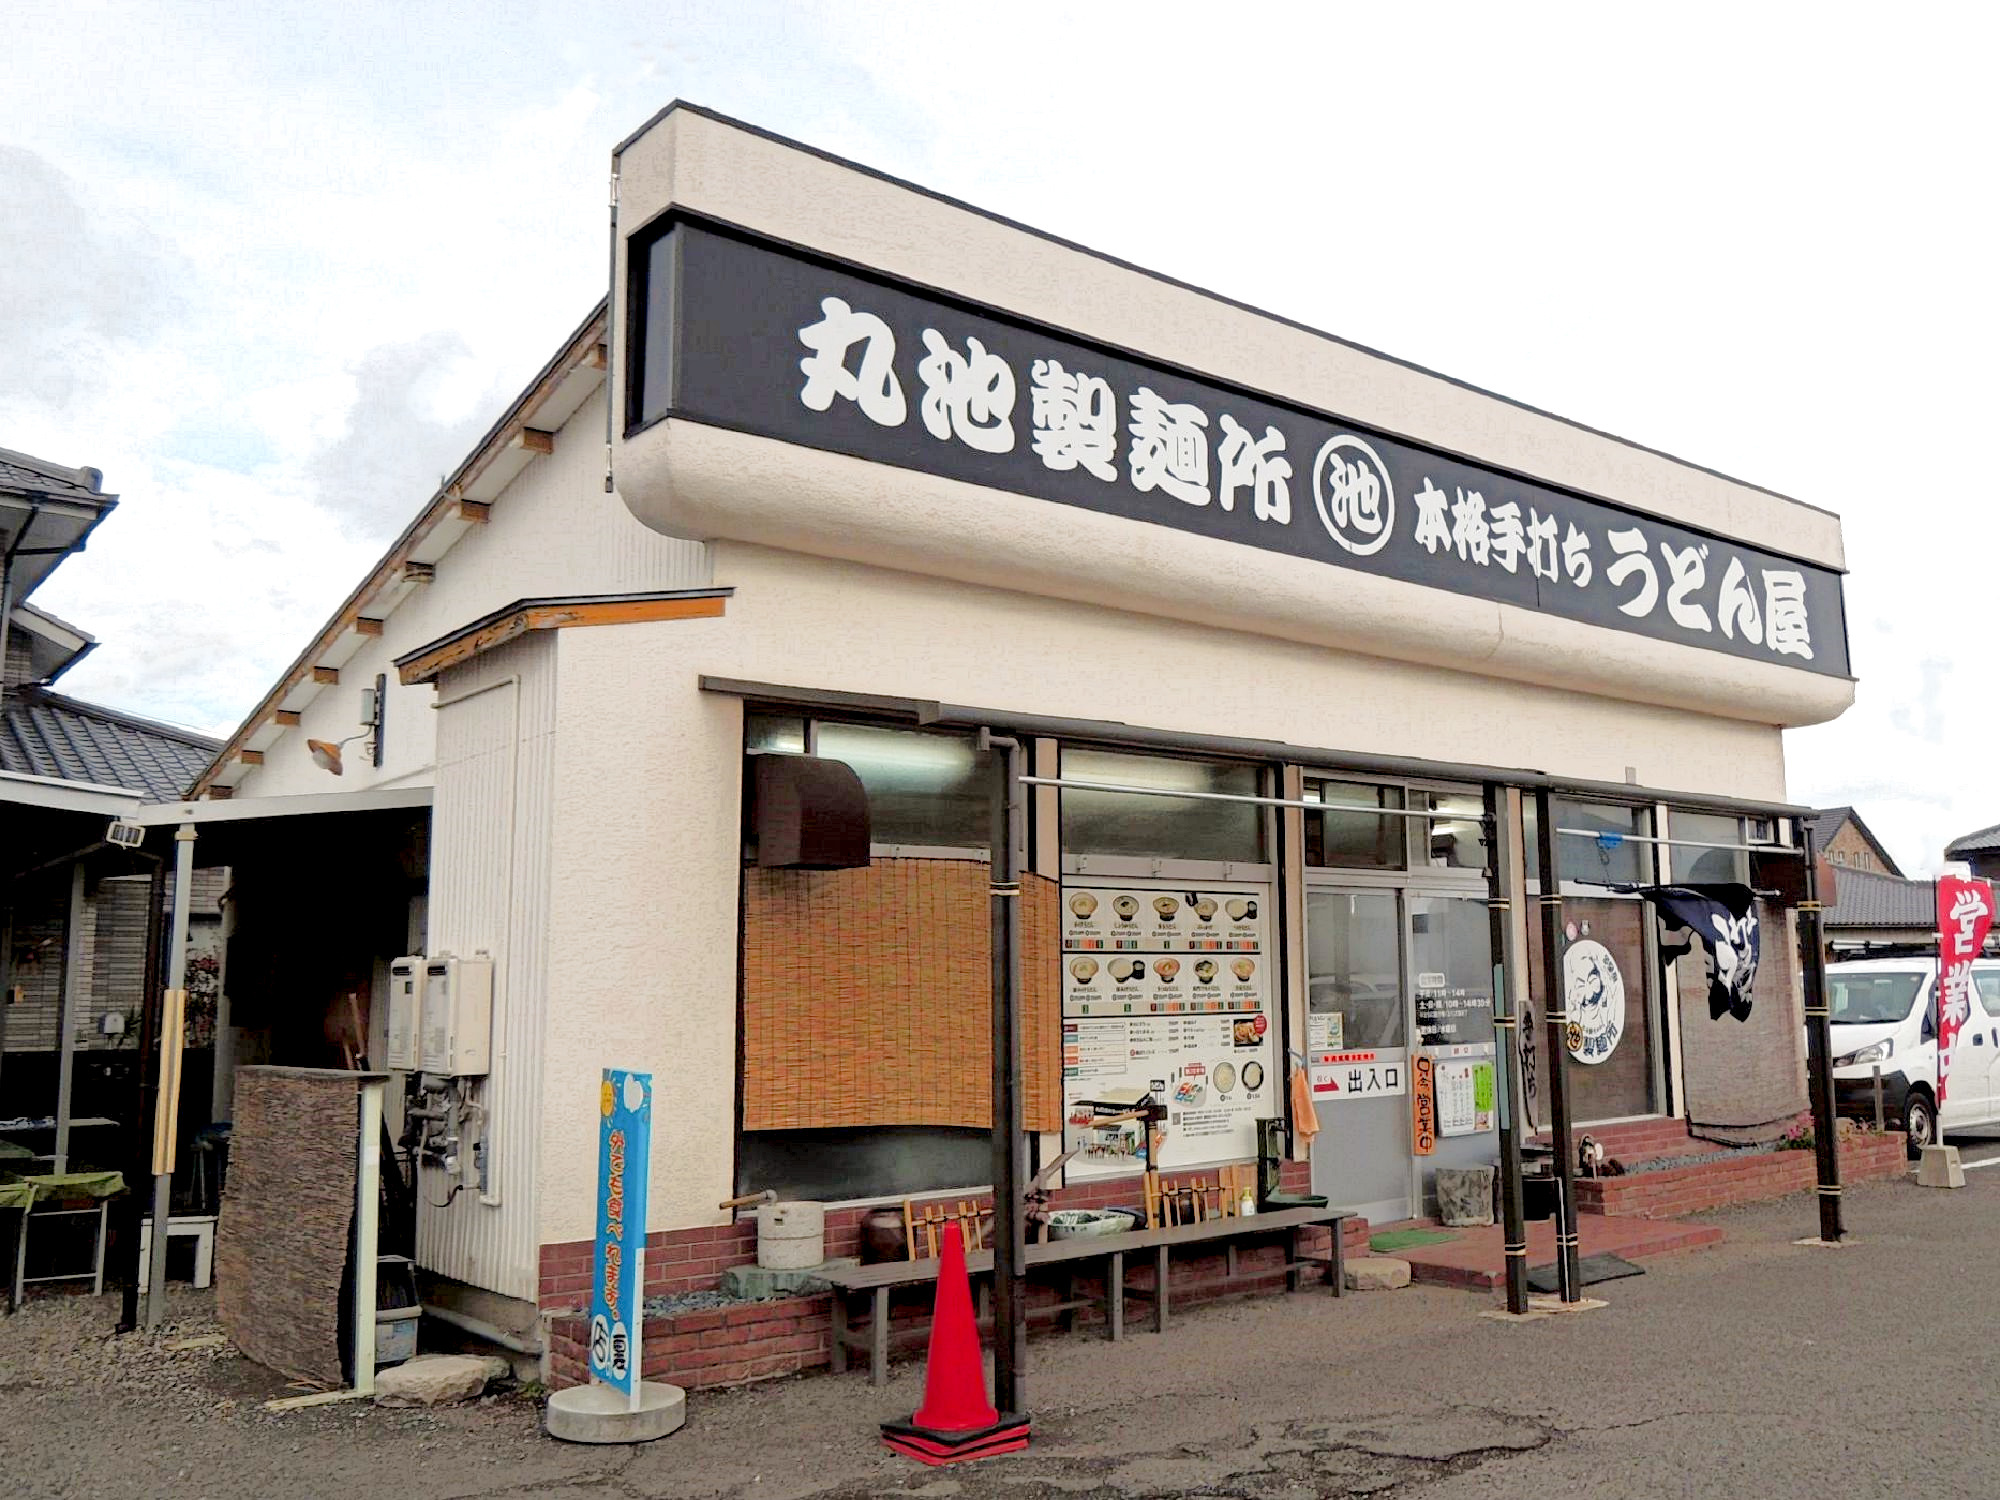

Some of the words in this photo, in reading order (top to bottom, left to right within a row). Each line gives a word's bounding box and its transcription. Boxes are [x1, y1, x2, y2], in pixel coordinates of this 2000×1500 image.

[799, 297, 1293, 525] 丸池製麺所
[1348, 1067, 1398, 1093] 出入口
